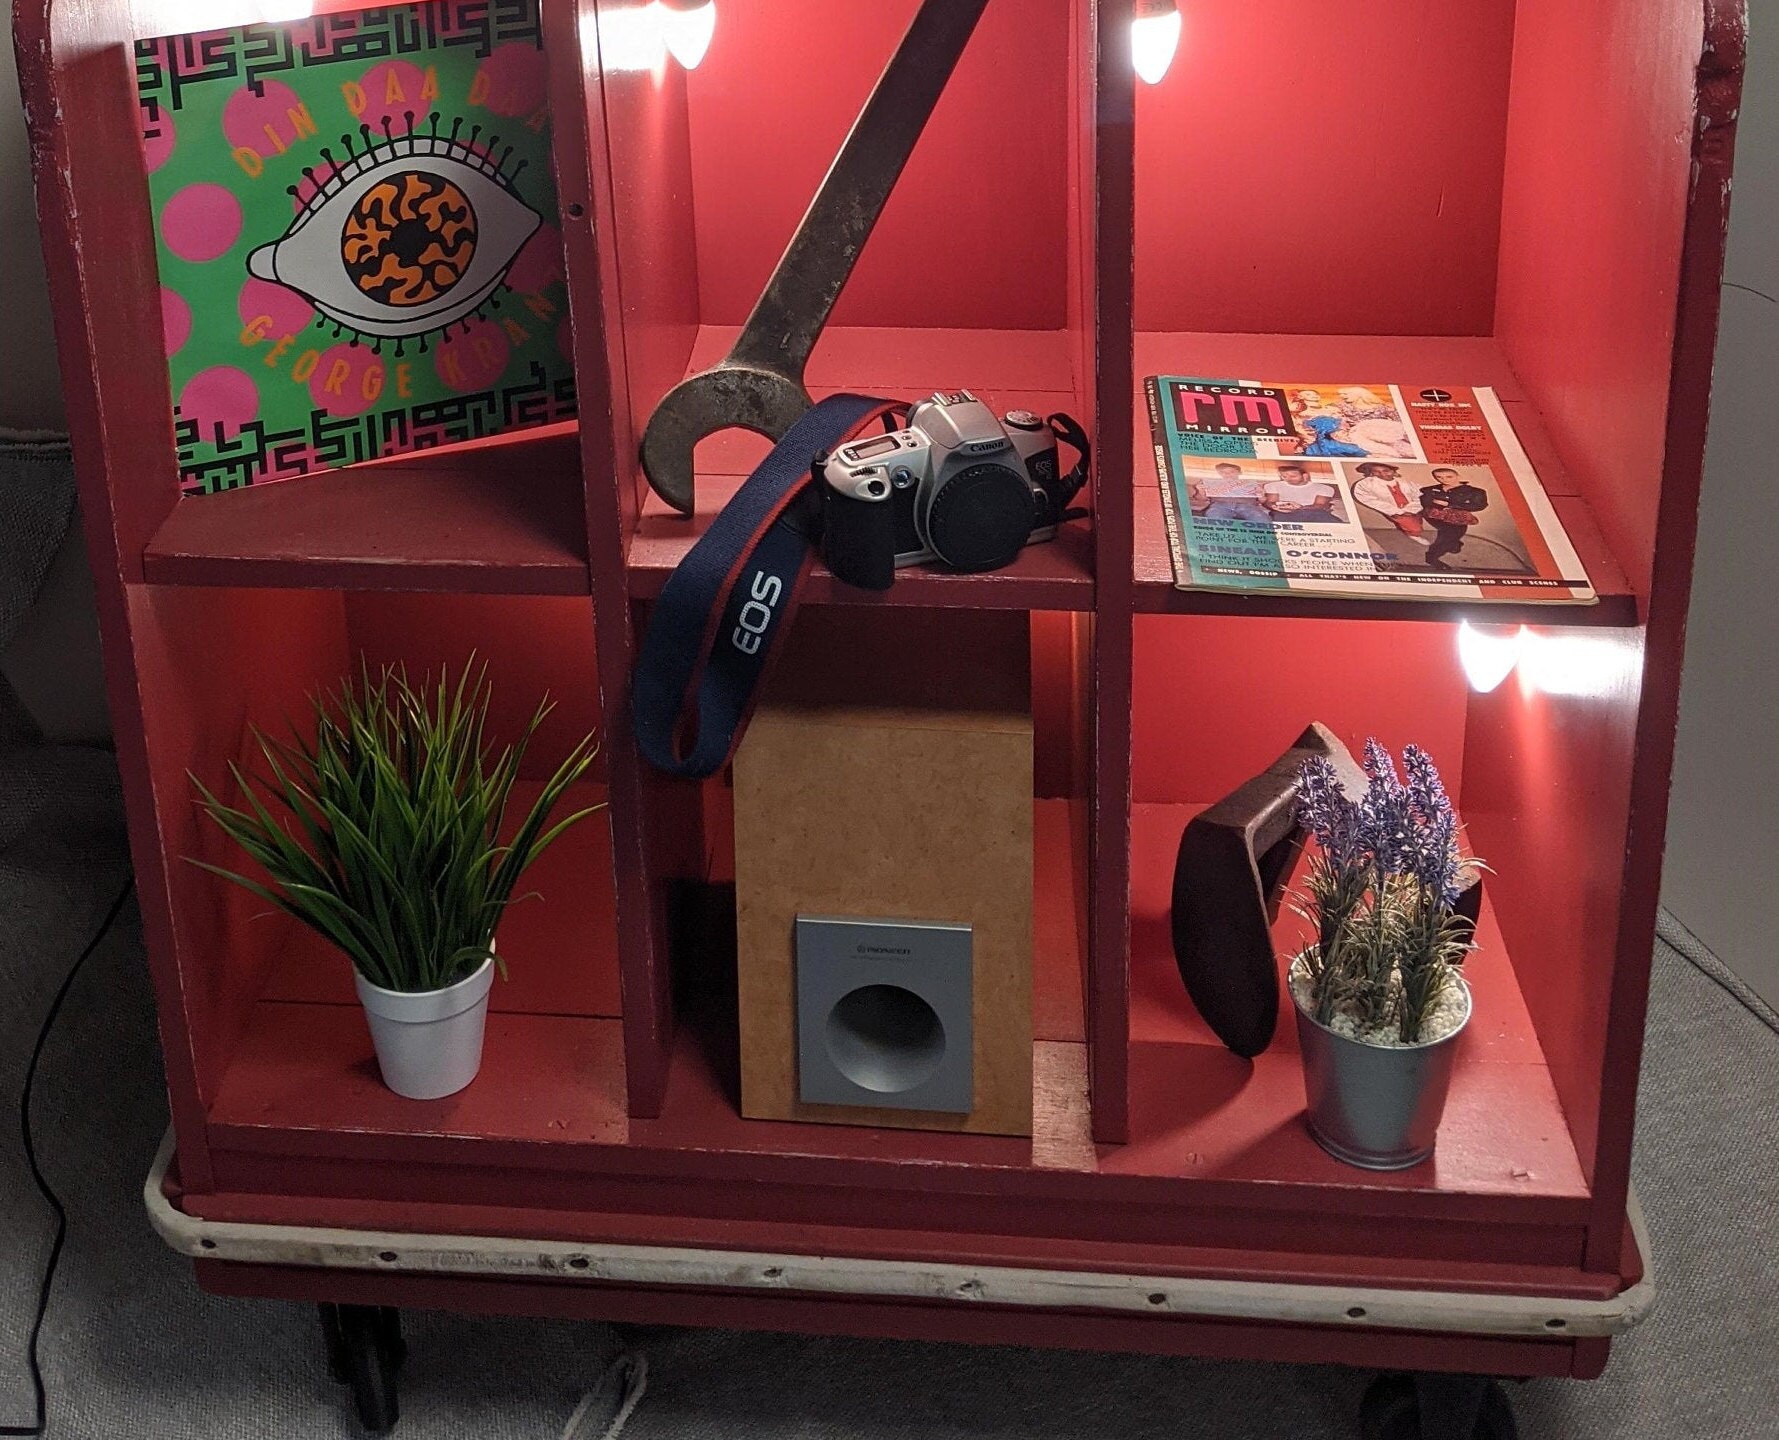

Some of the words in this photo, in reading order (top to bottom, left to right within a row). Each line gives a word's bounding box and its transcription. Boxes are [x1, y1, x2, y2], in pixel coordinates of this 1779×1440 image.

[231, 102, 318, 179] DIN
[342, 66, 439, 116] DAA
[240, 315, 413, 400] GEORGE
[1179, 384, 1275, 396] RECORD
[1180, 392, 1285, 427] rm
[1186, 424, 1287, 435] MIRROR
[970, 441, 1004, 452] Canon
[1193, 517, 1234, 526] NEW
[1241, 521, 1304, 531] ORDER
[1198, 544, 1272, 556] SINEAD
[1286, 550, 1399, 560] O'CONNOR
[732, 570, 782, 654] EOS
